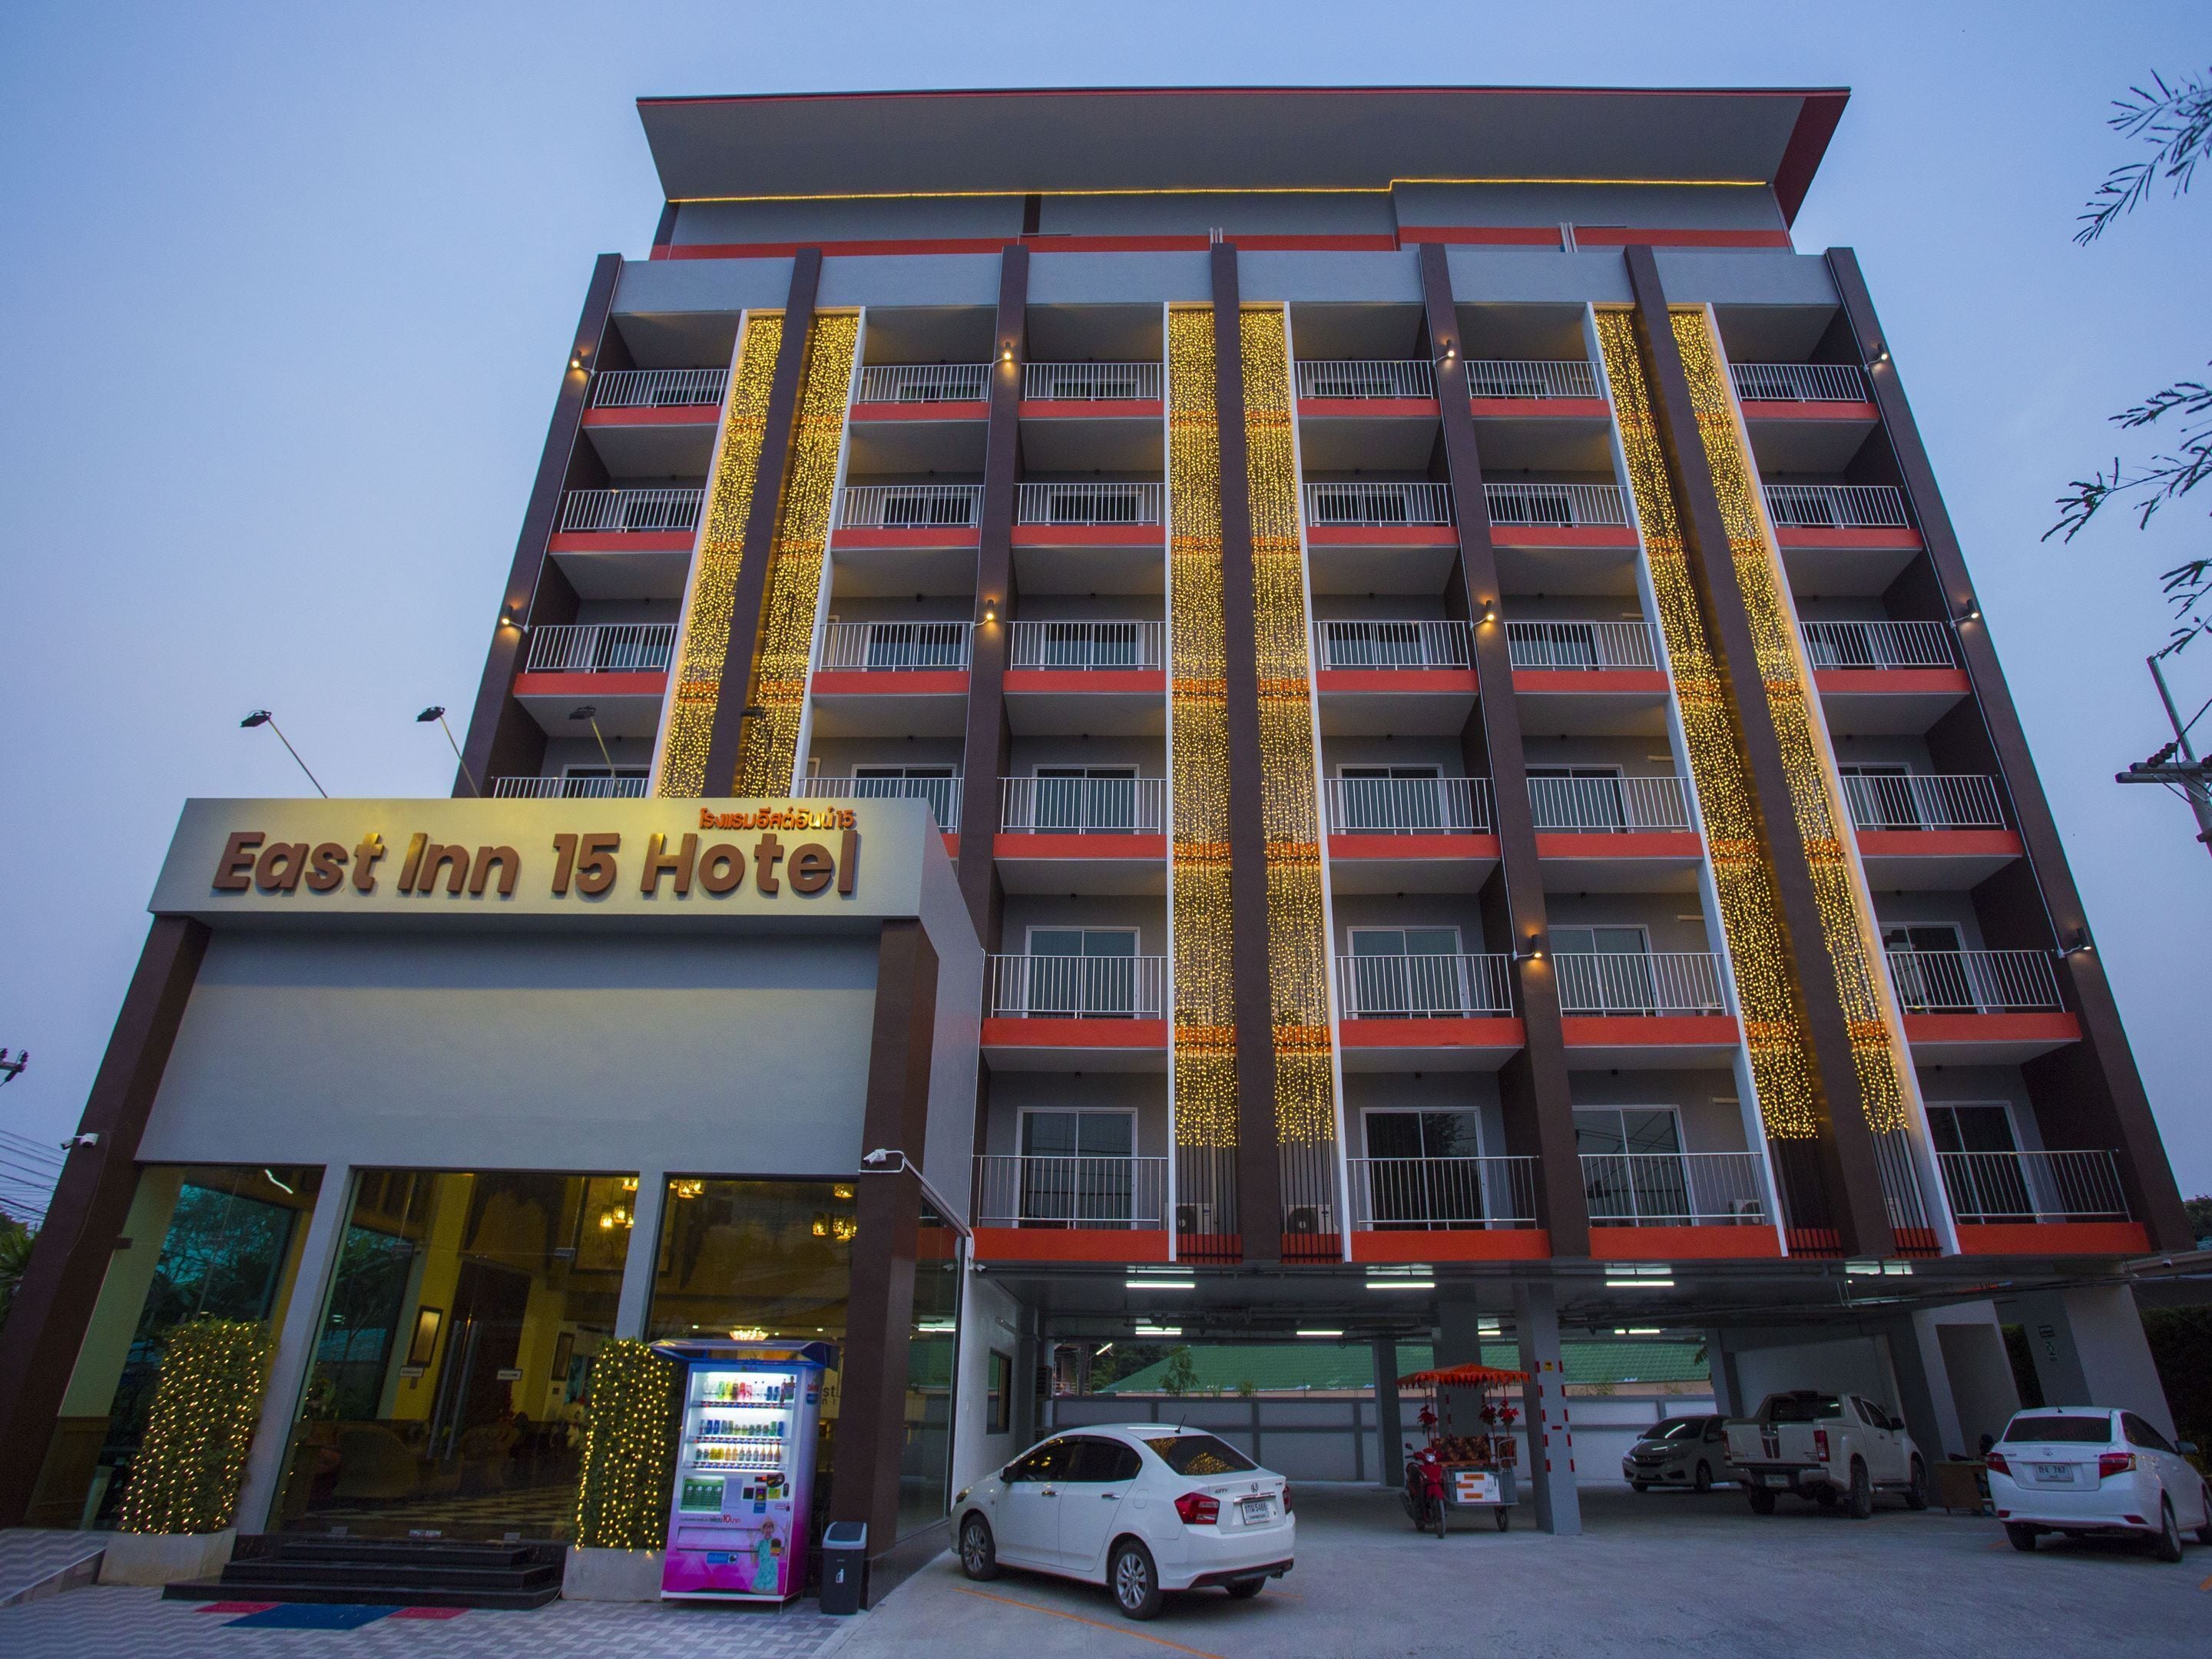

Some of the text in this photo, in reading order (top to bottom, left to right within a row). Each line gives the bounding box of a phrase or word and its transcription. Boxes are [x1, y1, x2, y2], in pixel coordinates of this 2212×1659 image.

[212, 830, 858, 893] East Inn 15 Hotel
